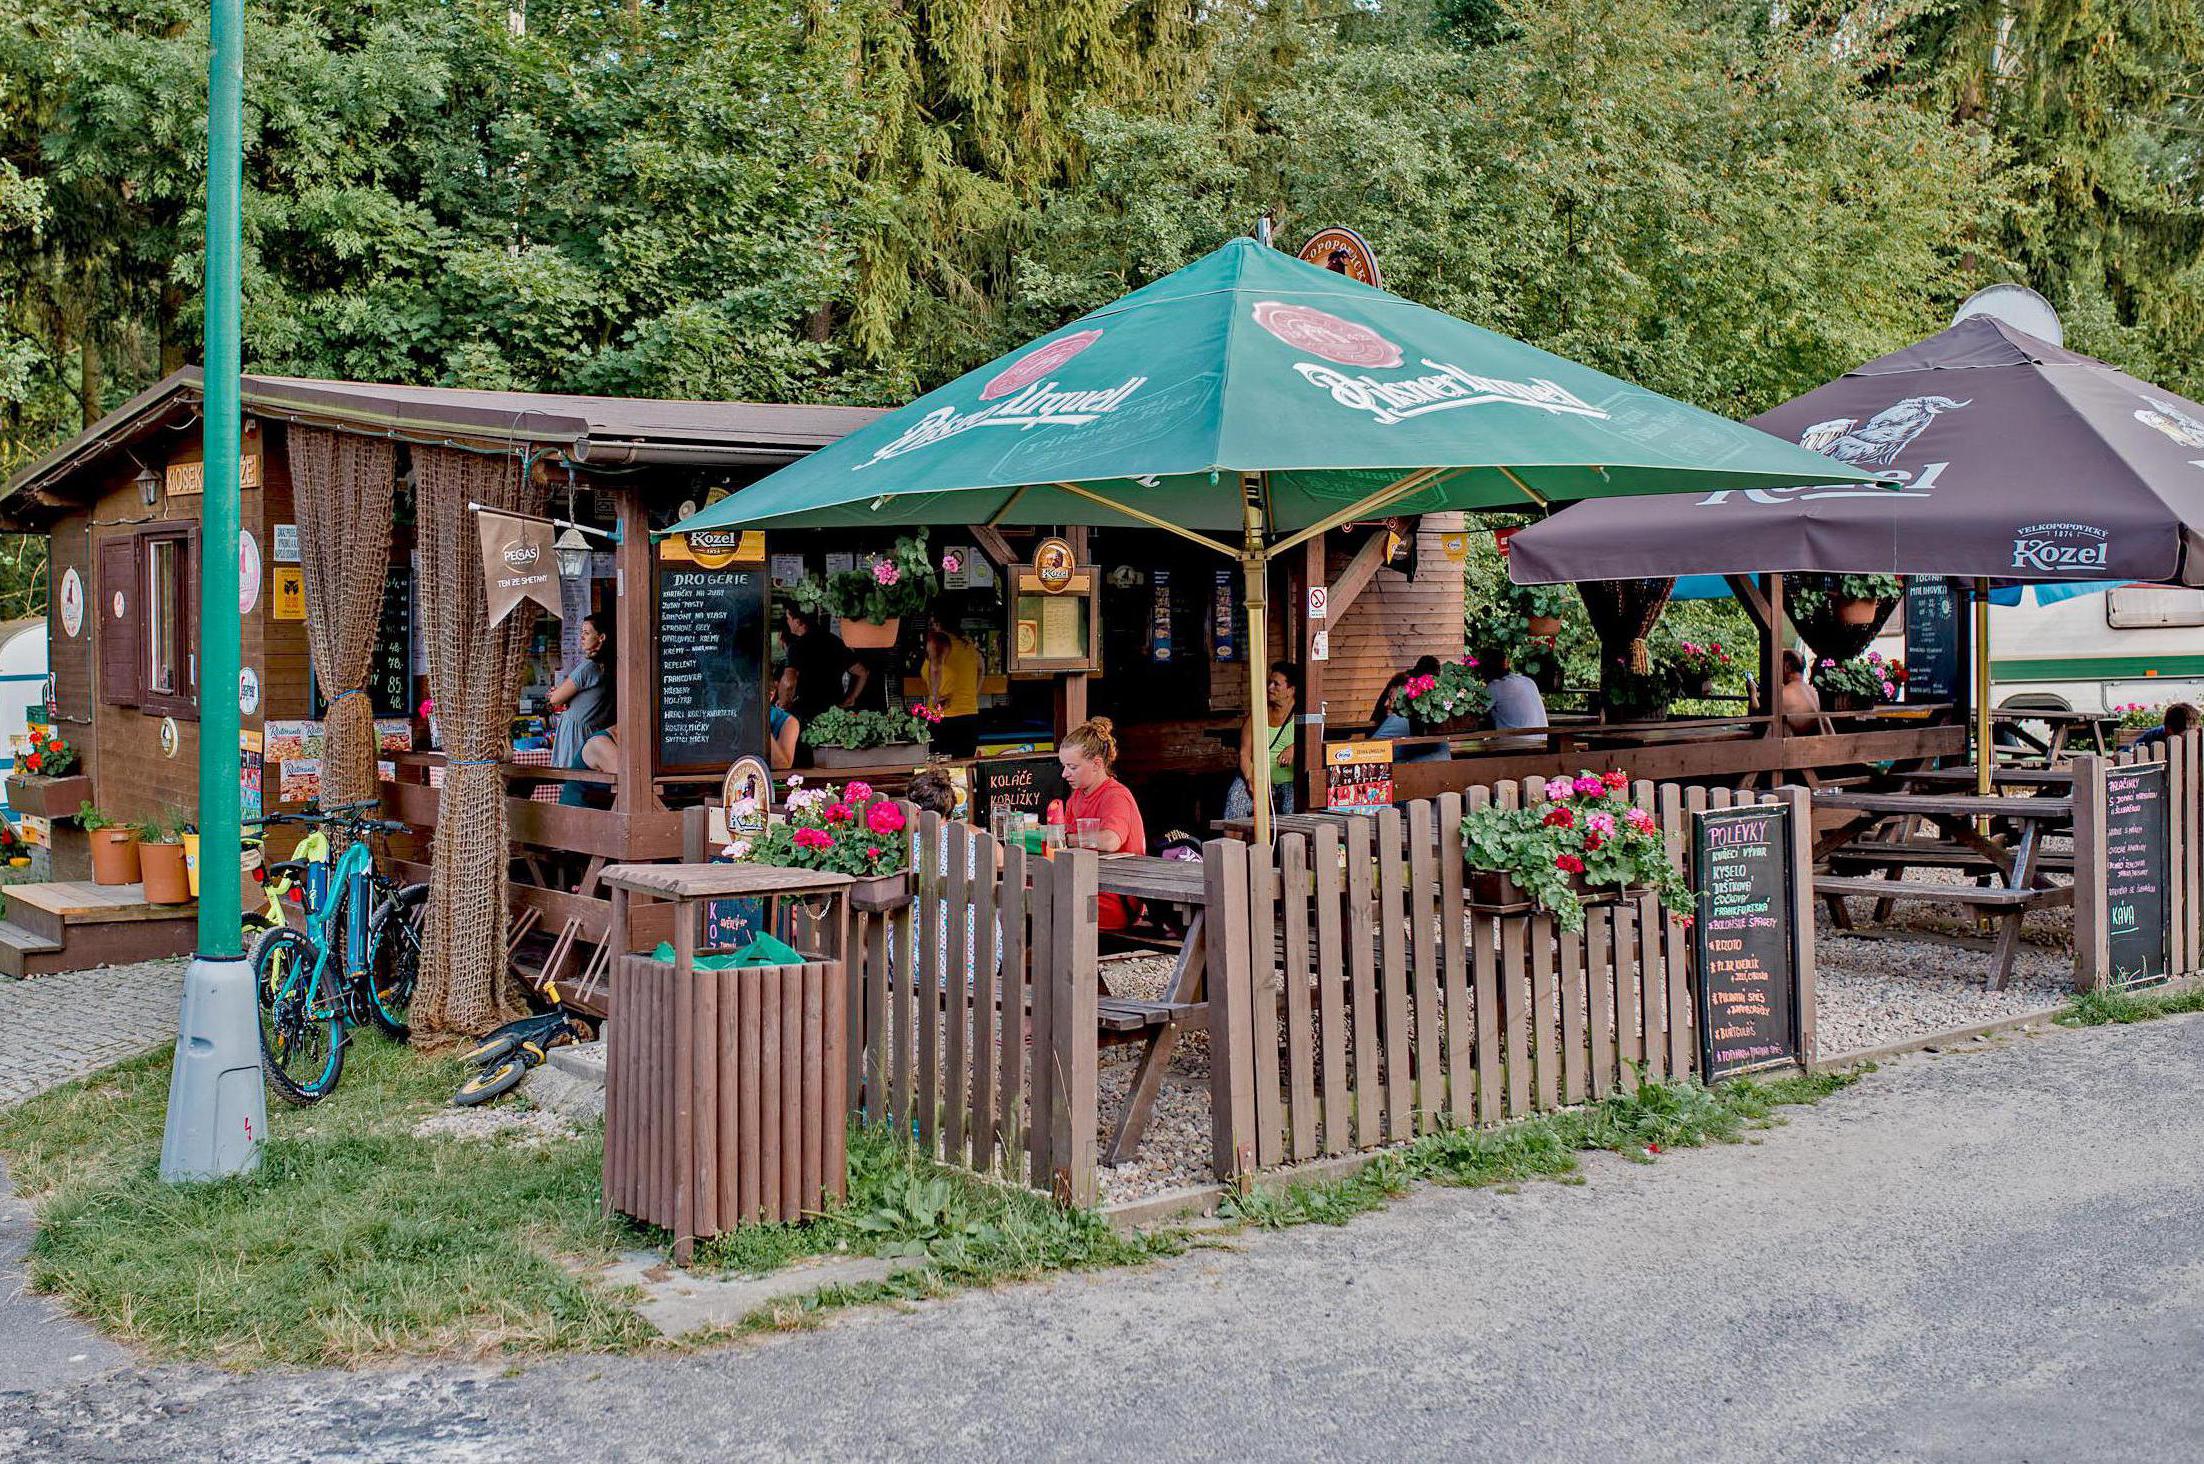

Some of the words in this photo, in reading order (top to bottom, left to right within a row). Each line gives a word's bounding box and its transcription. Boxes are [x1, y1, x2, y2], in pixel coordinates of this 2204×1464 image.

[690, 531, 736, 547] Kozel
[504, 548, 537, 561] PEGAS
[2011, 540, 2108, 571] Kozel
[497, 580, 511, 588] TEN
[521, 574, 548, 585] SMETANY
[1910, 585, 1948, 596] MALINOVKA
[664, 660, 697, 669] REPELENTY
[285, 763, 317, 776] Ristorante
[990, 770, 1033, 788] KOLÁČE
[1708, 820, 1768, 847] POLÉVKY
[1743, 845, 1767, 857] VÝVAR
[1713, 865, 1746, 879] KYSELO
[2112, 901, 2135, 925] KÁVA
